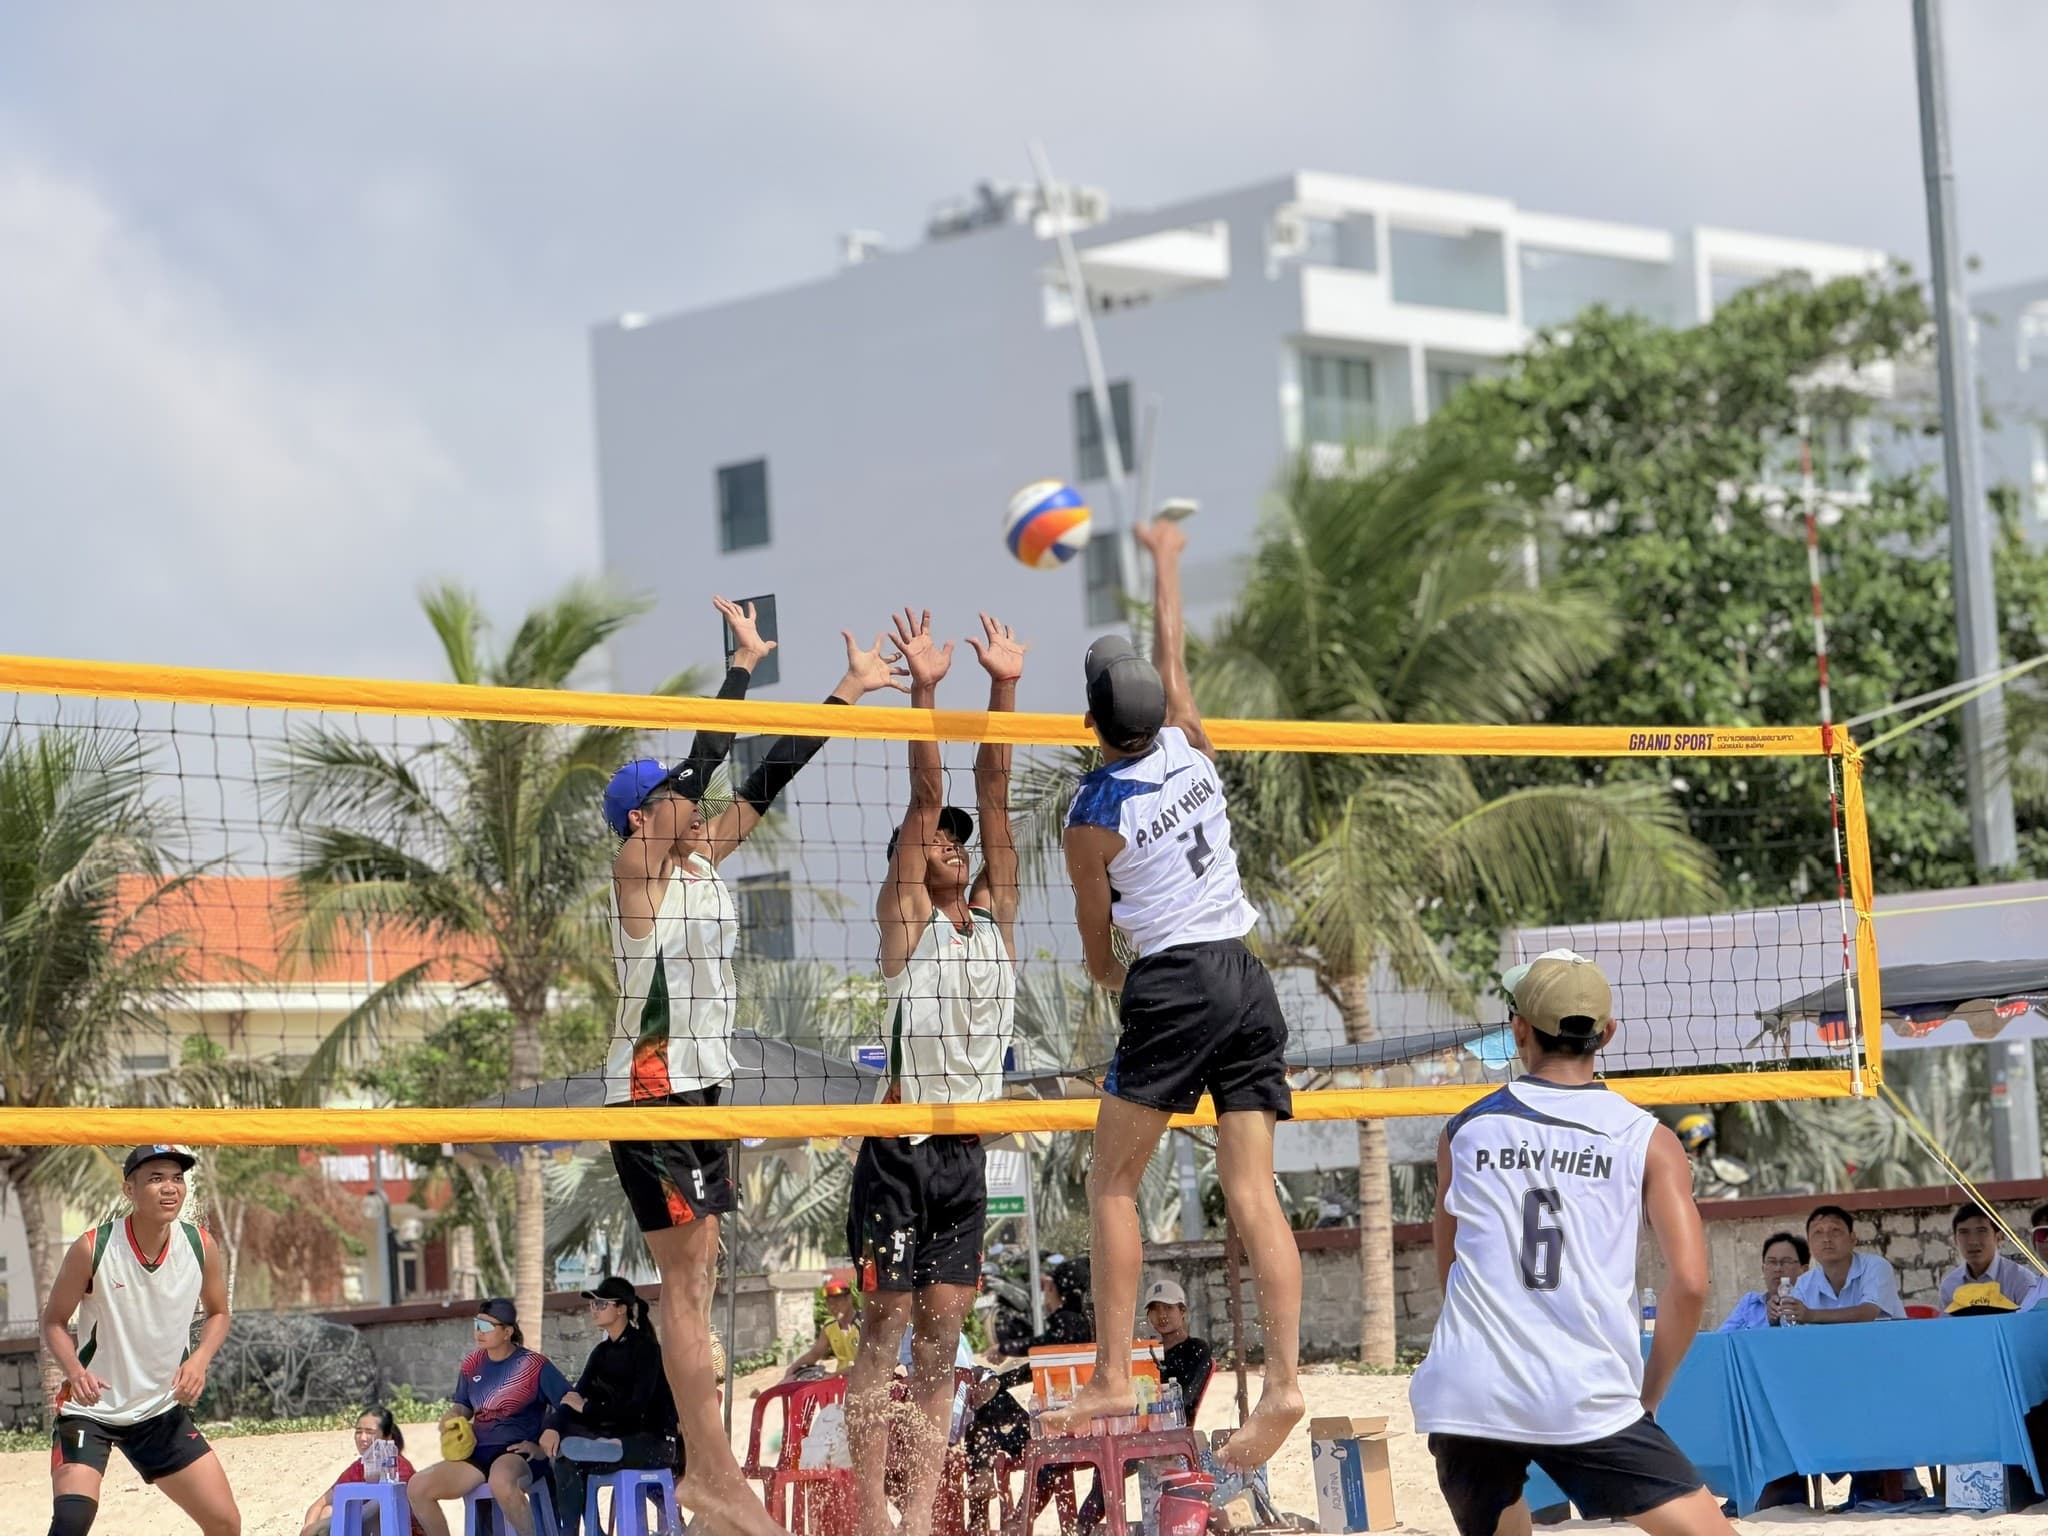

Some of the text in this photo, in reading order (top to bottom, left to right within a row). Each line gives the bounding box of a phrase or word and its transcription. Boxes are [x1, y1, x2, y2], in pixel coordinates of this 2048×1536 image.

[1629, 733, 1671, 750] GRAND
[1674, 733, 1715, 750] SPORT
[1500, 1140, 1545, 1171] BẢY
[1550, 1145, 1613, 1179] HIỀN
[691, 1168, 705, 1200] 2
[893, 1232, 906, 1262] 5
[1521, 1187, 1565, 1291] 6
[77, 1429, 85, 1448] 1
